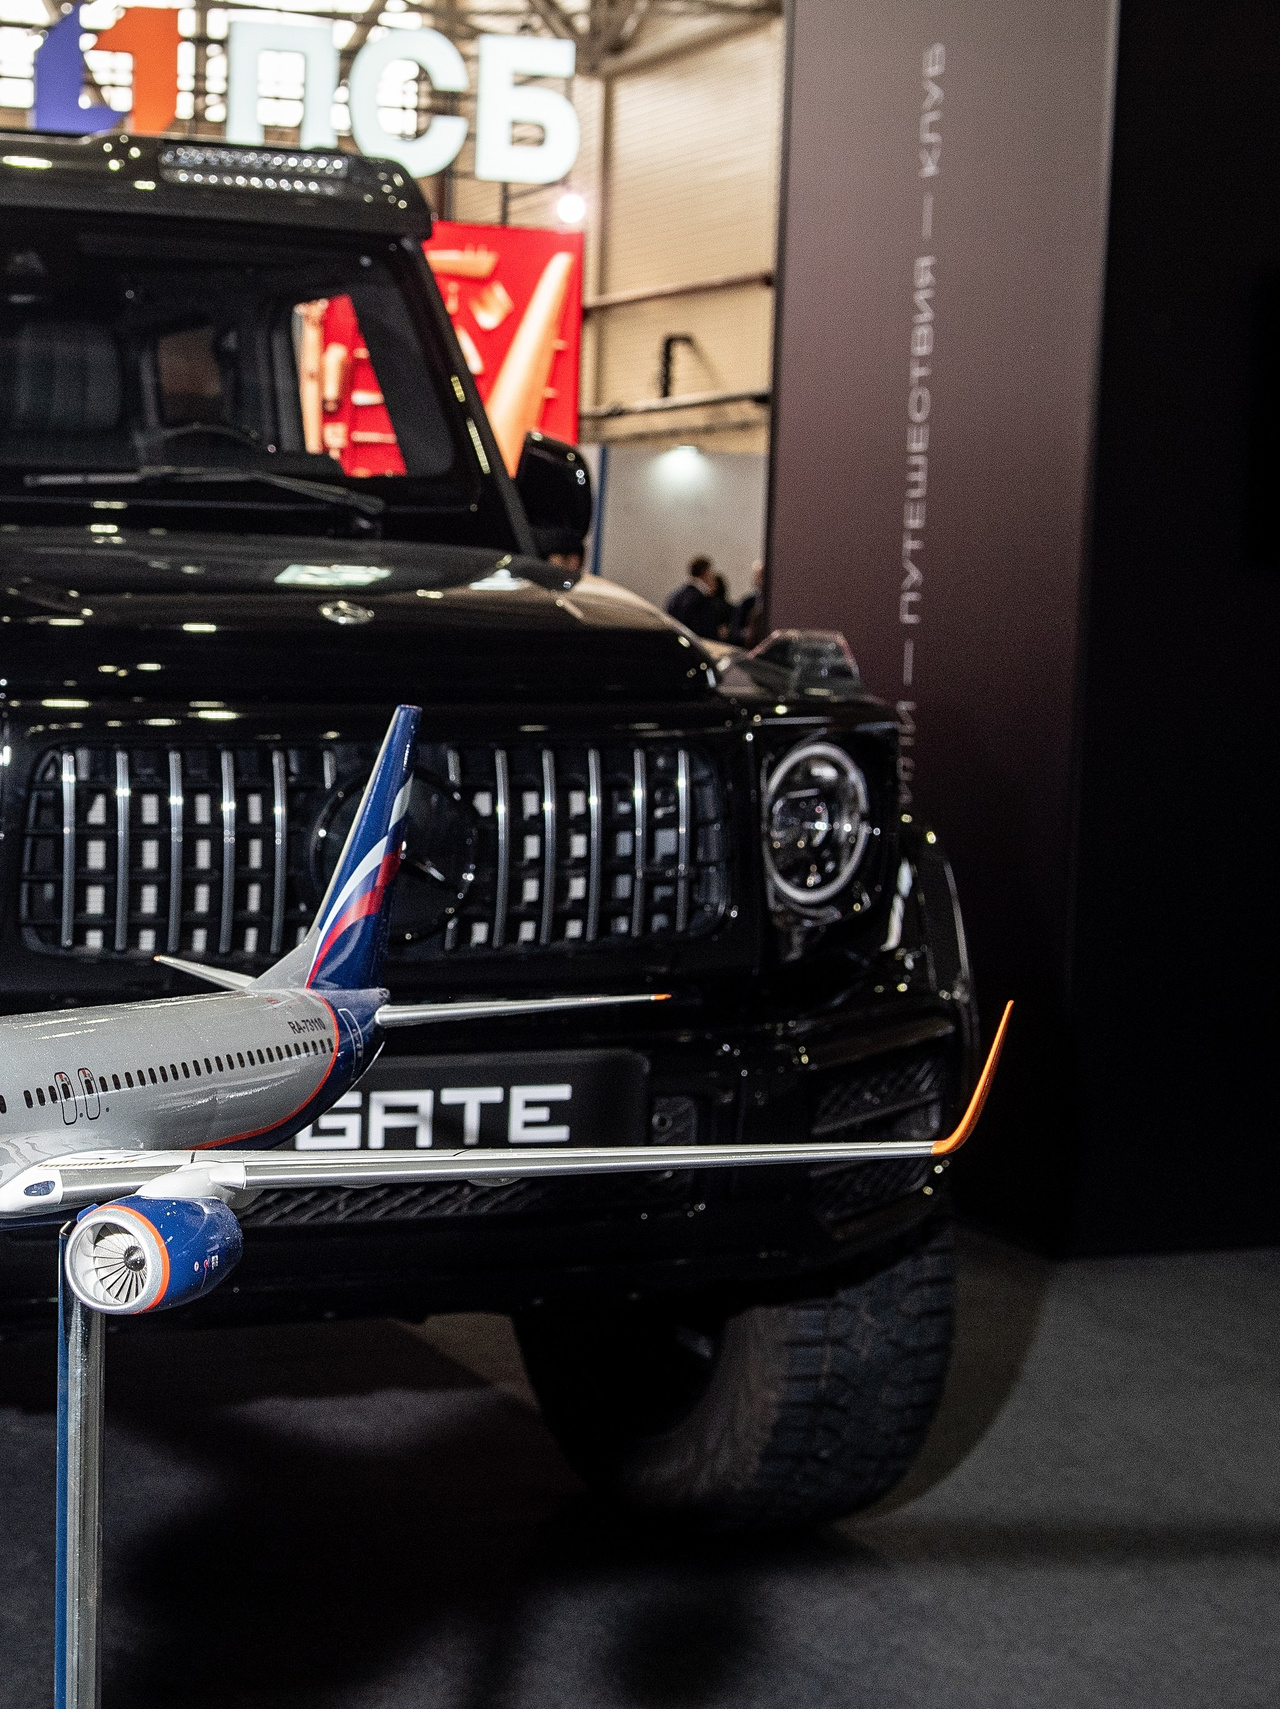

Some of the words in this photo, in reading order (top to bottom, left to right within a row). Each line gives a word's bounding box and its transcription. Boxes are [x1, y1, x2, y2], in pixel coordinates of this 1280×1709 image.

[228, 21, 580, 184] ПСБ
[918, 42, 946, 178] КЛУБ
[295, 1084, 572, 1150] GATE
